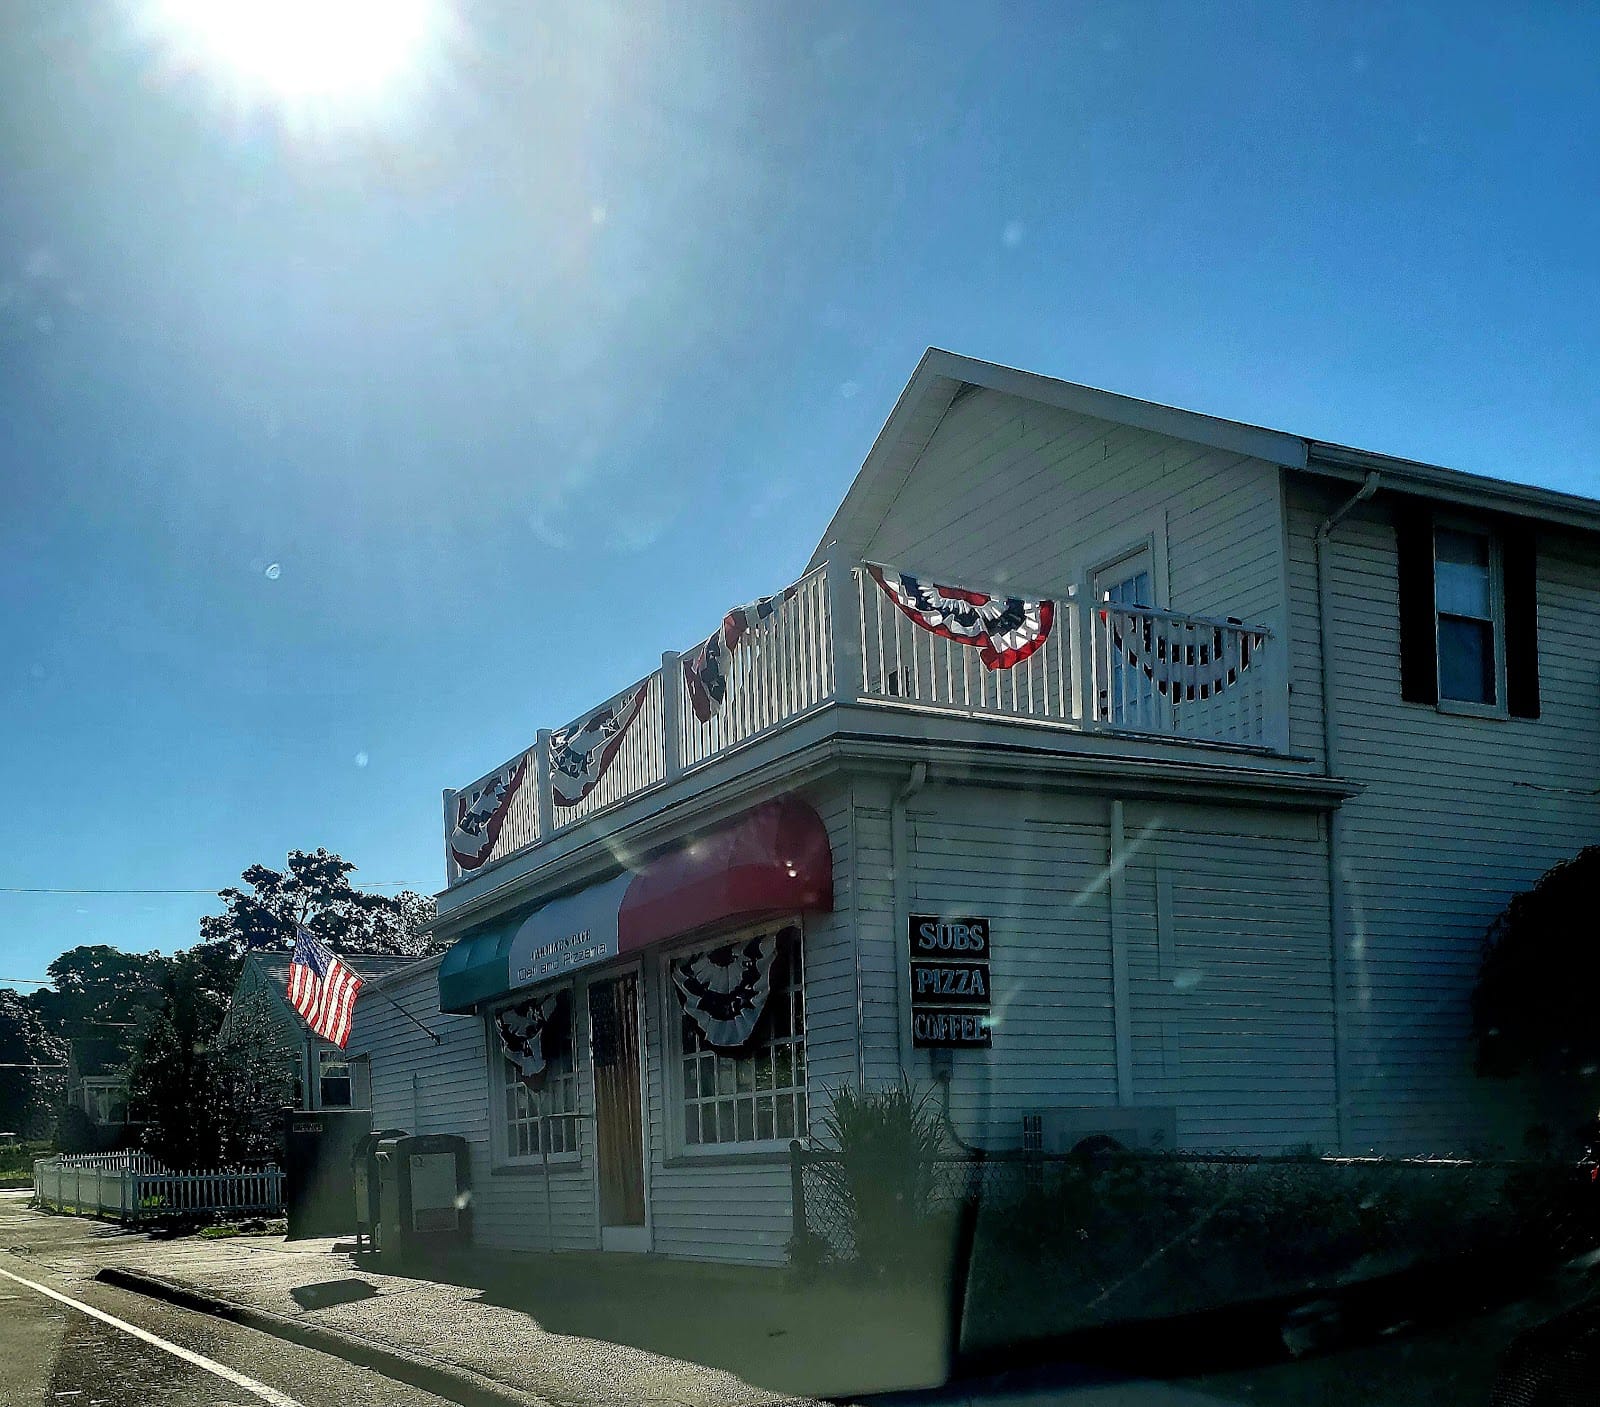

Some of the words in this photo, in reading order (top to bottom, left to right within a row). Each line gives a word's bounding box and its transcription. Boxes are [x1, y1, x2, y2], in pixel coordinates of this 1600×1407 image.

[919, 923, 984, 951] SUBS
[563, 943, 607, 967] Pizzeria
[916, 968, 985, 995] PIZZA
[914, 1014, 987, 1041] COFFEE
